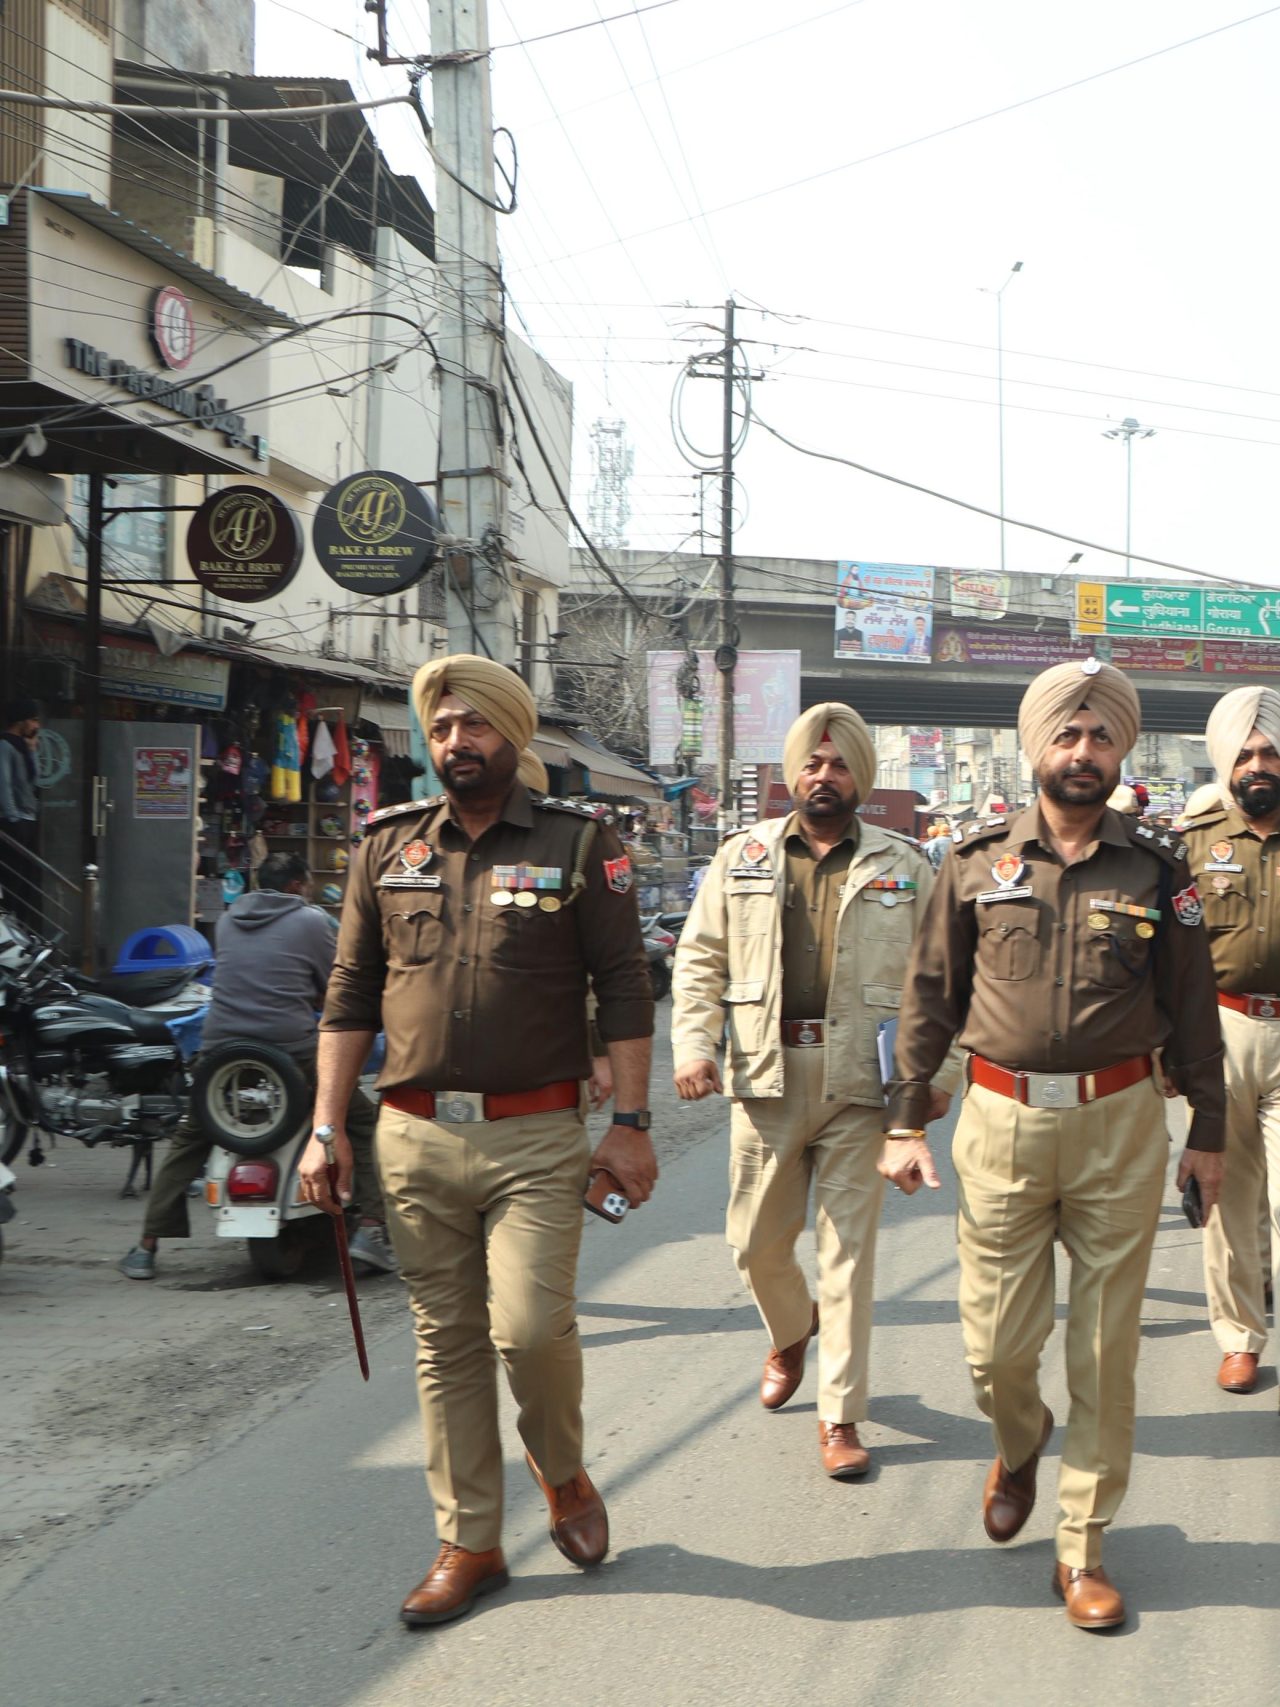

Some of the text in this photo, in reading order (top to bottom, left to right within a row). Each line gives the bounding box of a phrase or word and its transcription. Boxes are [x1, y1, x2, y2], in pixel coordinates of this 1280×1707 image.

[328, 545, 415, 556] BAKE & BREW
[199, 561, 284, 574] BAKE & BREW
[1084, 606, 1099, 615] 44
[1142, 620, 1200, 633] Ludhiana
[1206, 623, 1252, 637] Goraya
